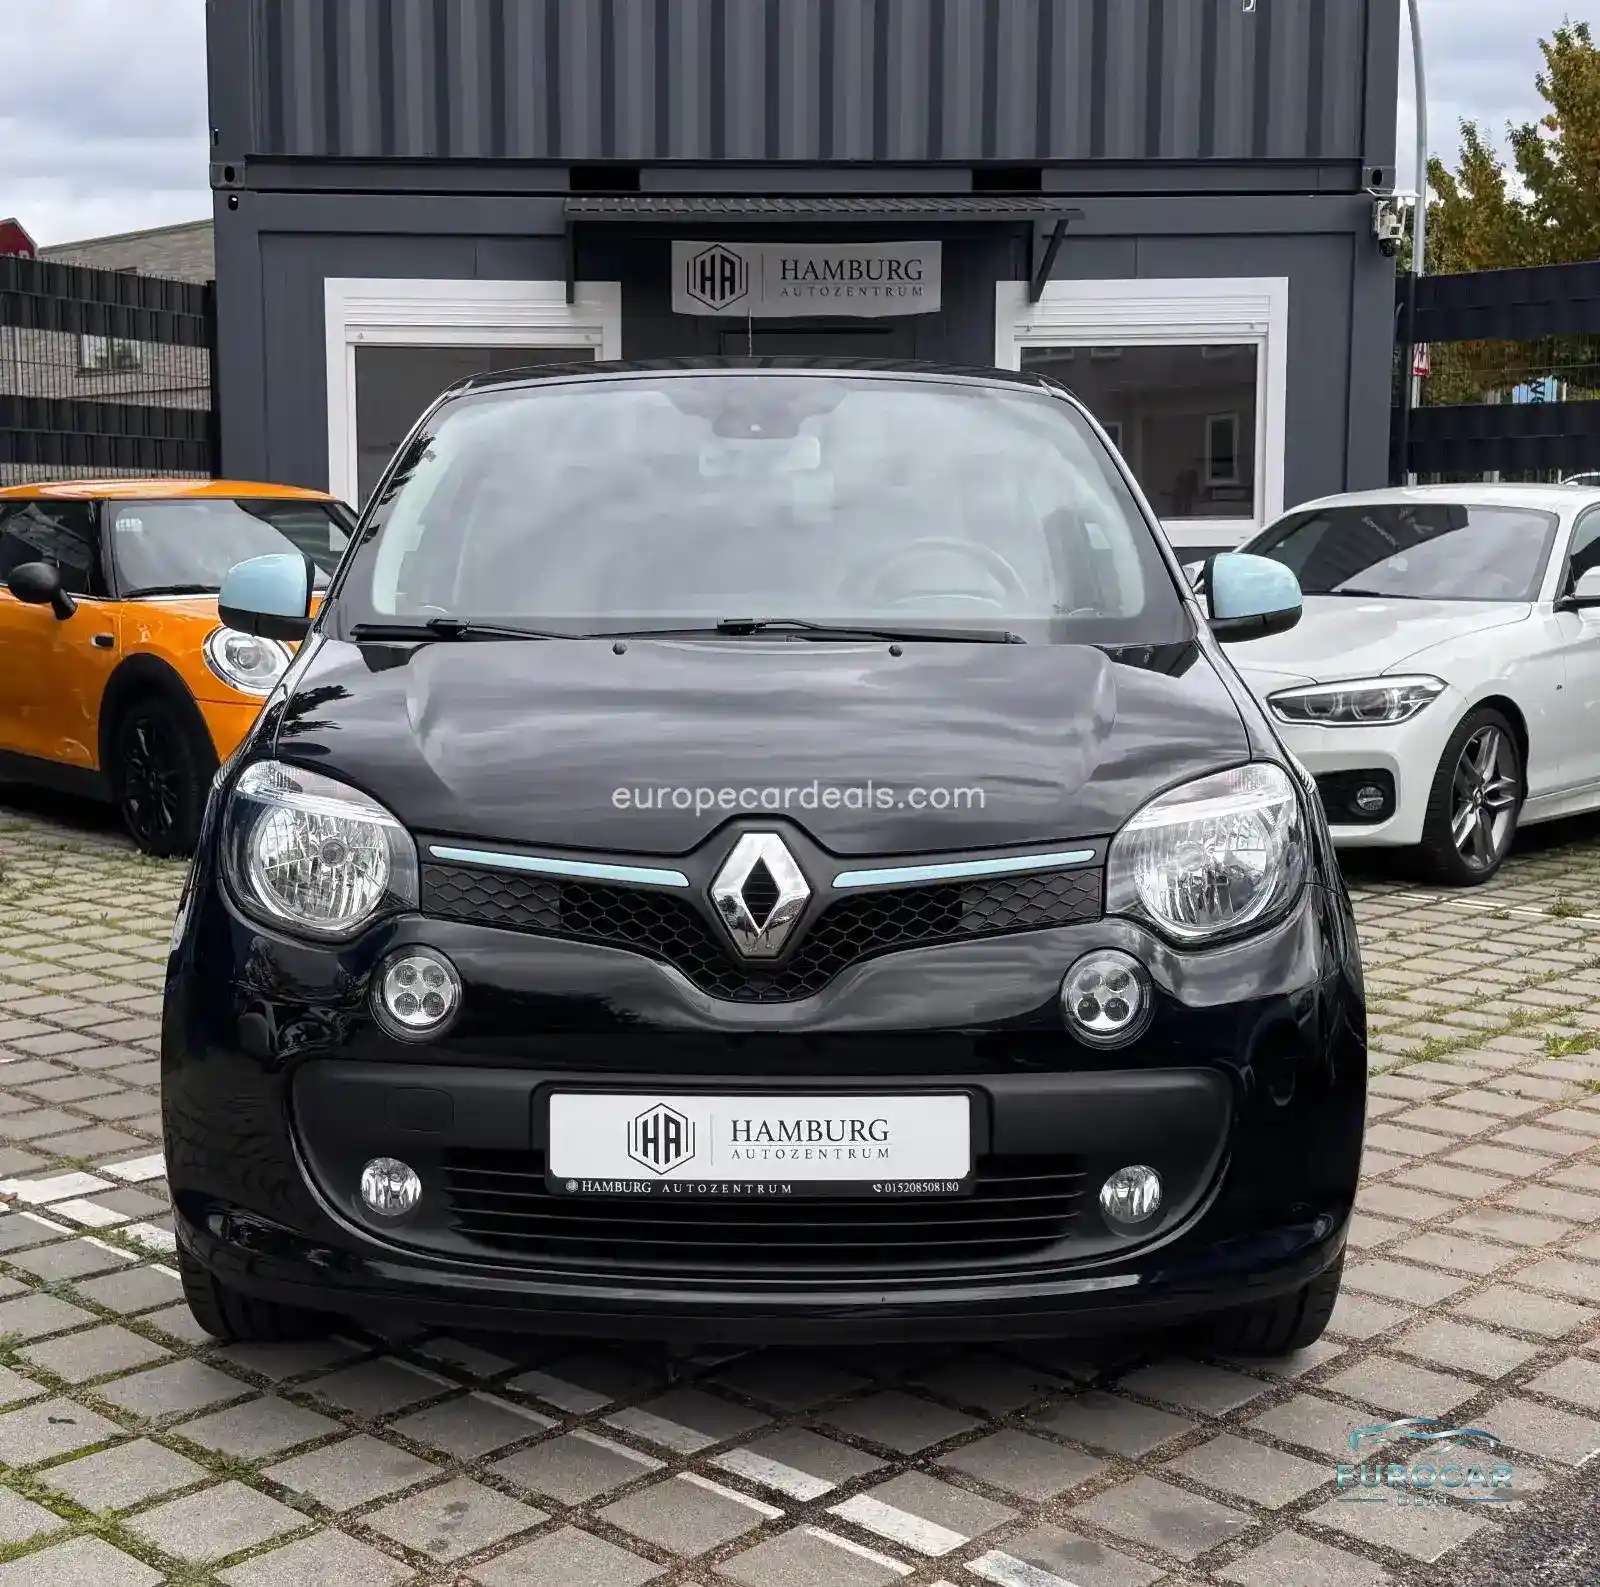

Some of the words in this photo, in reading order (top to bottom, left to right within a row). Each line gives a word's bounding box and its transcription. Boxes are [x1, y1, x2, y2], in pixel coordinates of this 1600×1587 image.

[780, 258, 923, 281] HAMBURG
[780, 286, 924, 297] AUTOZENTRUM
[731, 1118, 890, 1142] HAMBURG
[731, 1148, 890, 1160] AUTOZENTRUM
[582, 1180, 652, 1193] HAMBURG
[662, 1184, 792, 1194] AUTOZENTRUM
[884, 1181, 959, 1193] 015208508180
